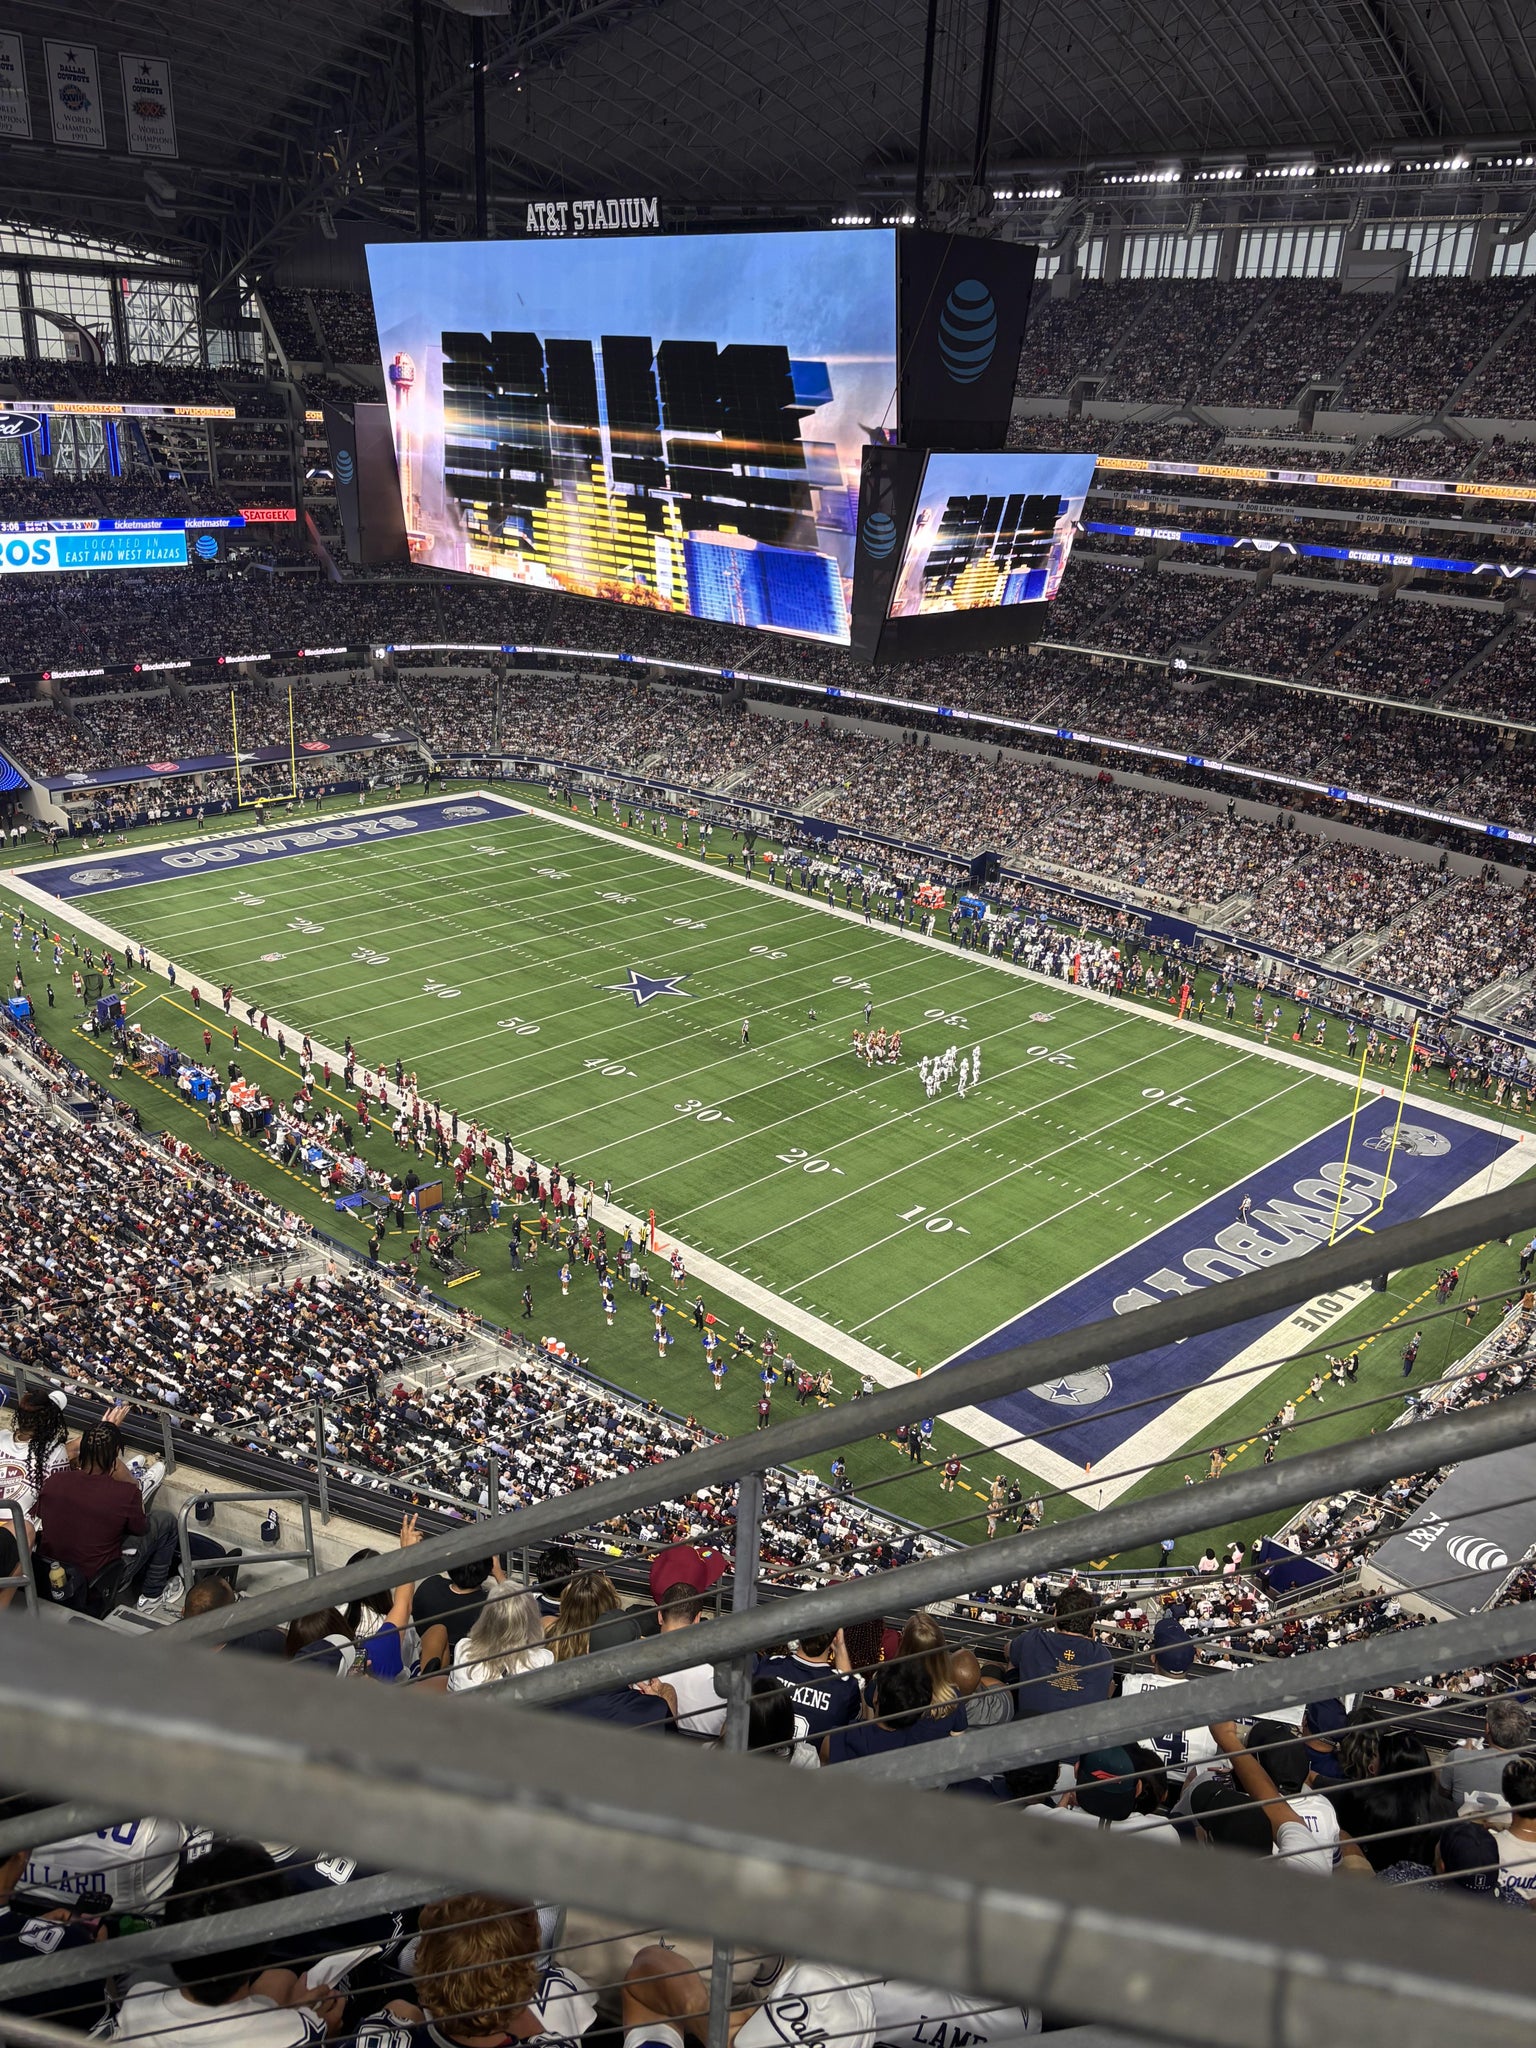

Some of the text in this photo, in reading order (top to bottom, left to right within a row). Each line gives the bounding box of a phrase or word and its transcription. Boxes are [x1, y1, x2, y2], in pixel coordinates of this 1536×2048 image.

[59, 64, 86, 75] DALLAS
[57, 72, 90, 83] COWBOYS
[134, 77, 160, 87] DALLAS
[132, 85, 163, 95] COWBOYS
[63, 114, 91, 124] WORLD
[56, 122, 101, 134] CHAMPIONS
[138, 125, 164, 135] WORLD
[526, 197, 660, 232] AT&T STADIUM
[244, 510, 290, 521] SEATGEEK
[114, 519, 162, 529] ticketmaster
[185, 518, 230, 528] ticketmaster
[1153, 529, 1181, 540] ACCESS
[84, 537, 159, 550] LOCATED IN
[65, 548, 180, 563] EAST AND WEST PLAZAS
[1348, 551, 1381, 562] OCTOBER
[304, 647, 347, 656] Blockchain.com
[225, 654, 271, 664] Blockchain.com
[142, 661, 191, 671] Blockchain.com
[51, 669, 104, 680] Blockchain.com
[199, 827, 257, 842] TAKES
[266, 821, 295, 831] ALL
[304, 816, 324, 824] OF
[161, 816, 418, 868] COWBOYS
[230, 892, 266, 906] 10
[287, 919, 325, 934] 20
[351, 948, 390, 965] 30
[749, 945, 788, 960] 50
[422, 981, 461, 999] 40
[923, 1008, 968, 1026] 30
[496, 1016, 540, 1036] 50
[1026, 1045, 1076, 1066] 20
[582, 1057, 628, 1077] 40
[673, 1099, 723, 1122] 30
[775, 1147, 830, 1175] 20
[895, 1204, 954, 1234] 10
[1291, 1290, 1356, 1333] LOVE
